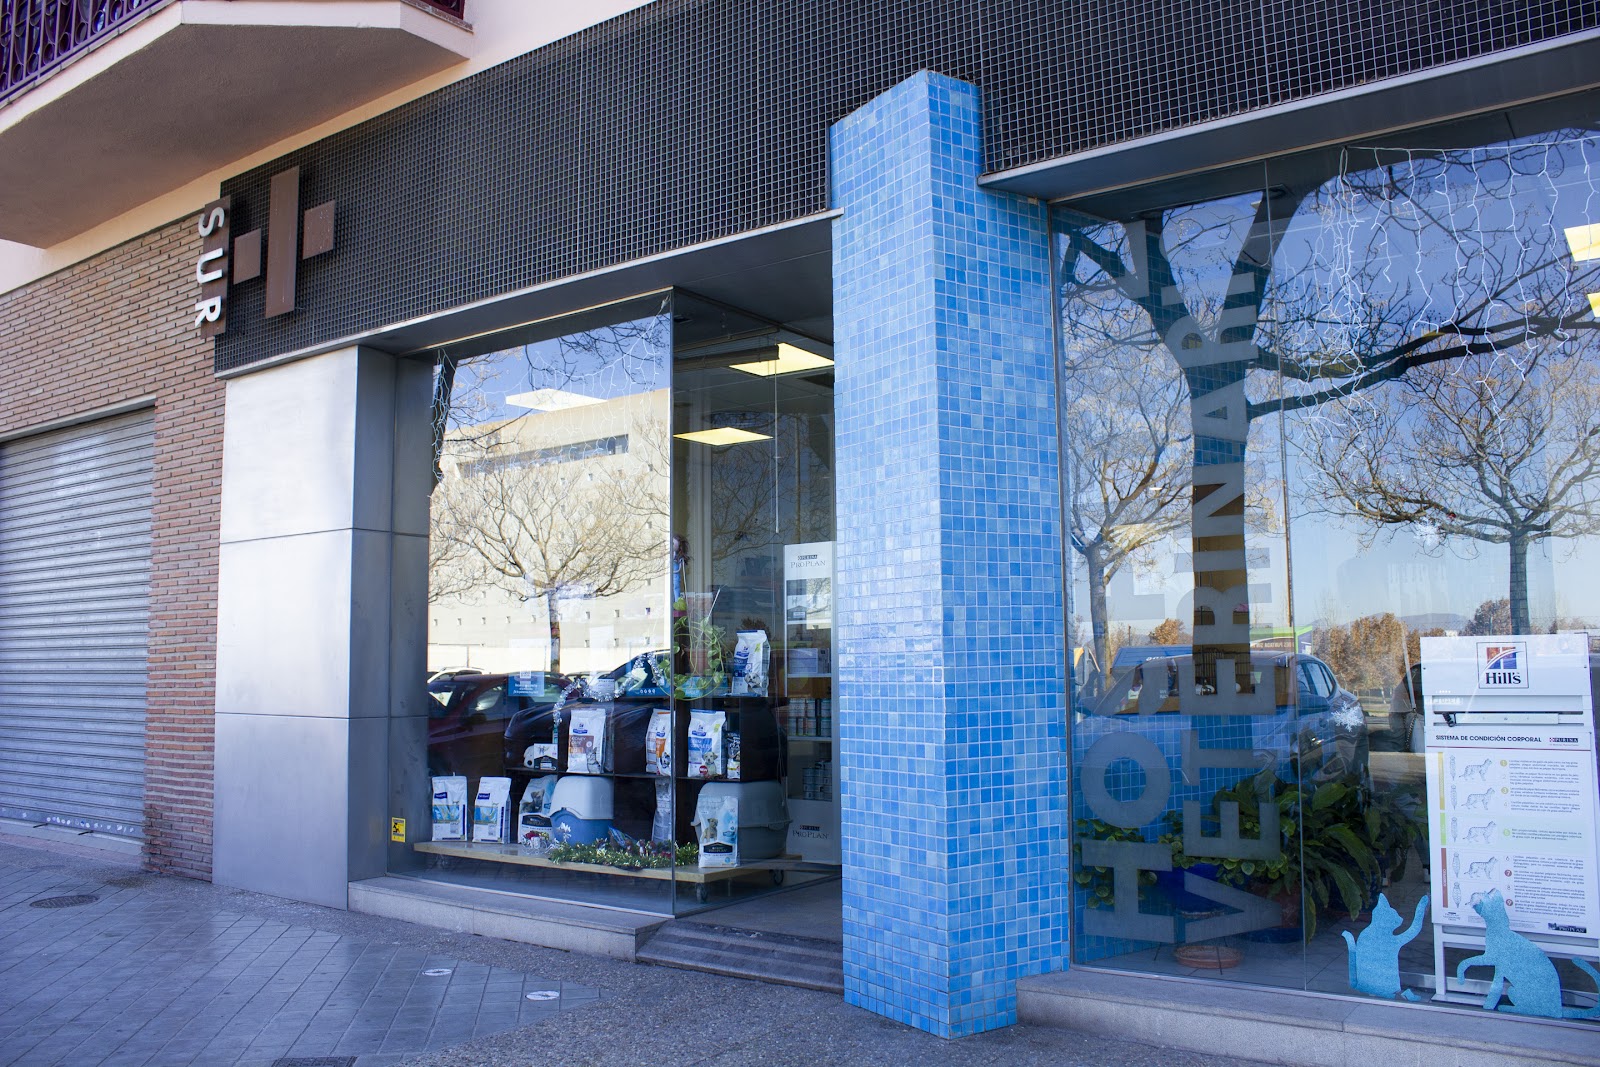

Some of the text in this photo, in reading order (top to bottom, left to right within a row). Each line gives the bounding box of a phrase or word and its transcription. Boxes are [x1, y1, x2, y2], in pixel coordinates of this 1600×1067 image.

[194, 207, 224, 328] SUR
[1485, 672, 1522, 685] Hill's
[1469, 734, 1506, 742] CONDICIÓN
